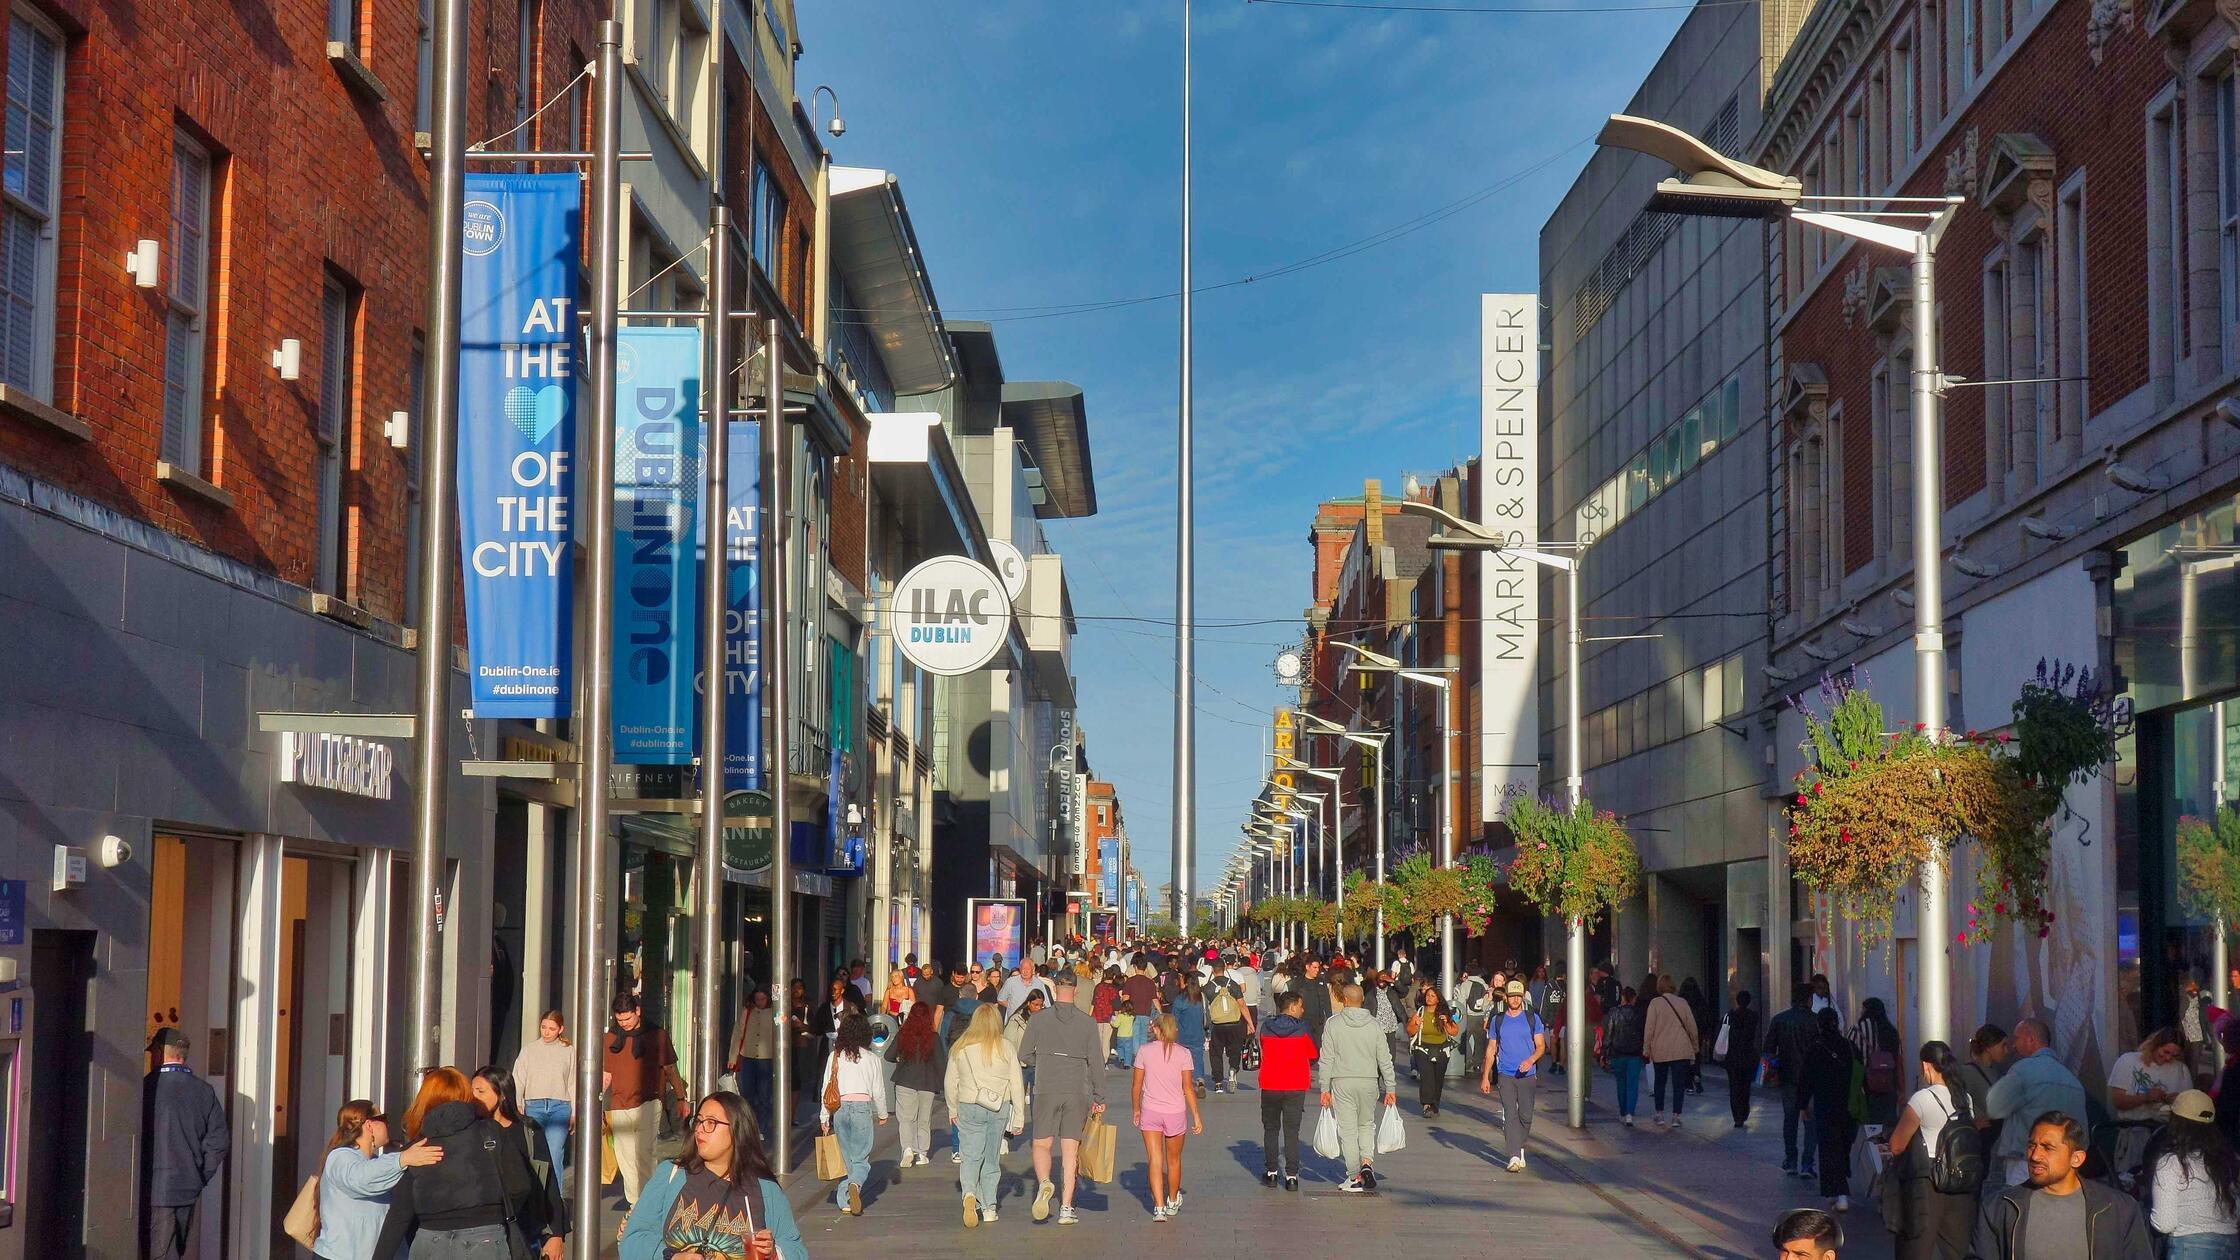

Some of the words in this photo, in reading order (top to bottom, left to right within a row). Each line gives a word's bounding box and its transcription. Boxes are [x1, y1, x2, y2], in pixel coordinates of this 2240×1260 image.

[464, 230, 493, 241] OWN
[522, 298, 572, 333] AT
[500, 343, 570, 378] THE
[1496, 307, 1524, 487] SPENCER
[511, 451, 568, 487] OF
[497, 496, 568, 532] THE
[727, 506, 756, 530] AT
[1496, 496, 1524, 519] &
[471, 541, 567, 578] CITY
[727, 536, 757, 561] HE
[911, 588, 989, 625] ILAC
[1496, 529, 1524, 659] MARKS
[725, 610, 757, 635] OF
[911, 627, 971, 643] DUBLIN
[725, 640, 758, 665] HE
[479, 665, 561, 678] Dublin-One.ie
[492, 684, 560, 696] #dublinone
[620, 725, 685, 735] Dublin-One.ie
[630, 739, 684, 749] #dublinone
[281, 731, 392, 800] PULL&BEAR
[728, 797, 769, 809] BAKERY
[1060, 769, 1070, 821] DIRECT
[1494, 784, 1527, 797] M&S
